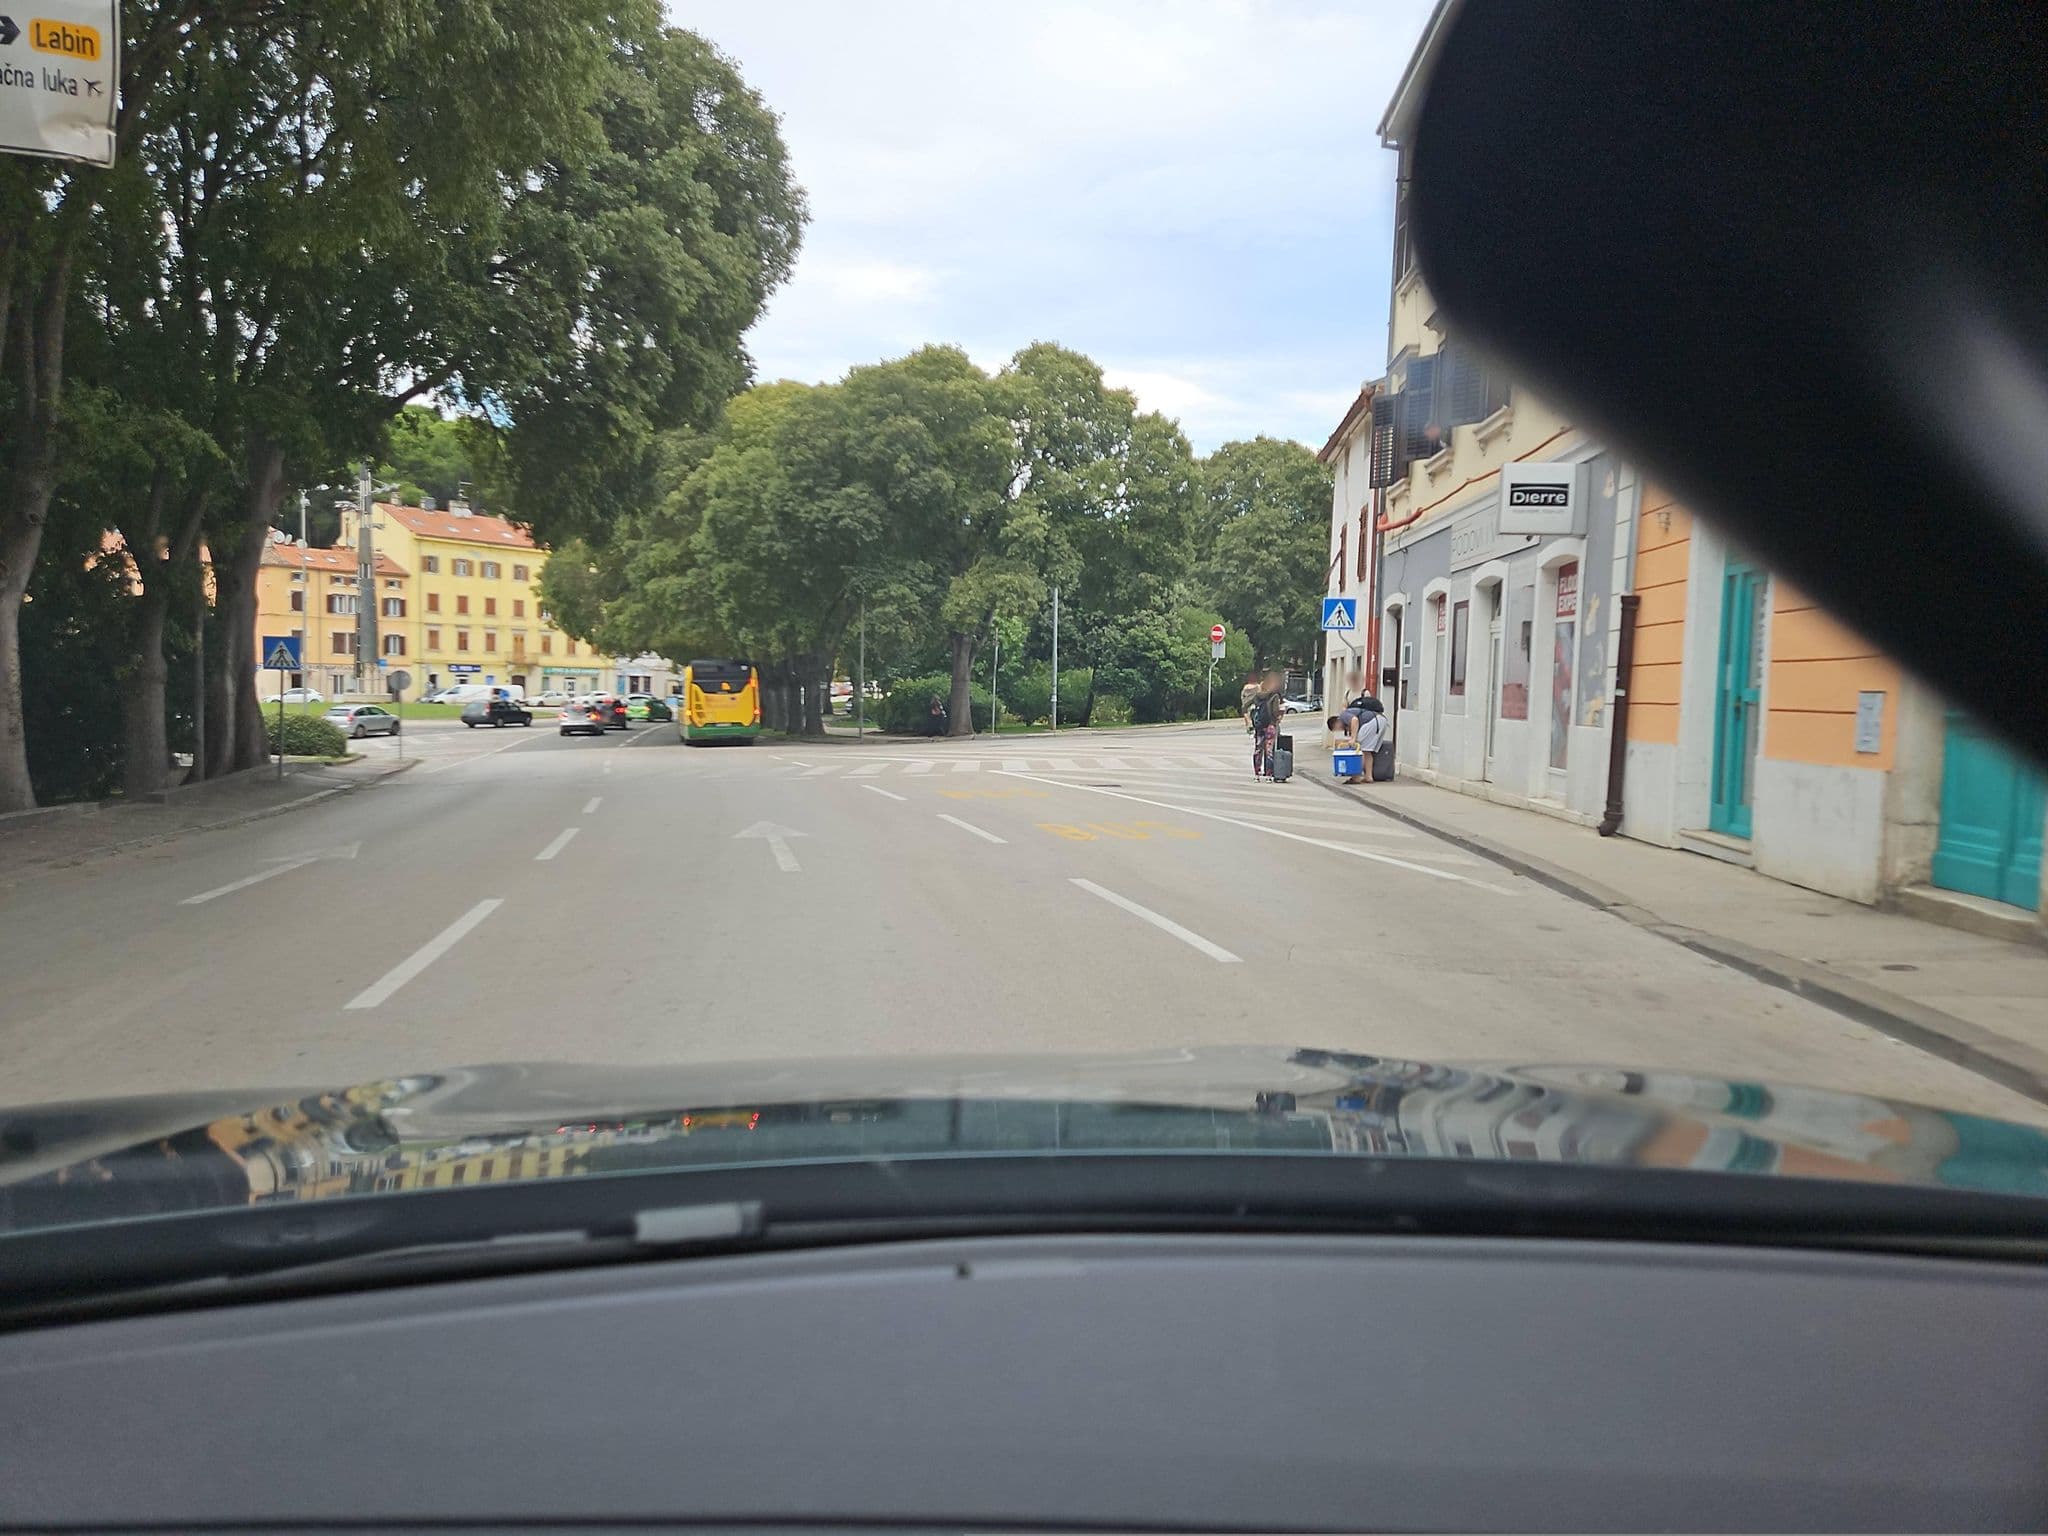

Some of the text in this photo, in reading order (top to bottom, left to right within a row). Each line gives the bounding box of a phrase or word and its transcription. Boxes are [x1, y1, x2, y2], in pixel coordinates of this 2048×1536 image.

[36, 22, 95, 56] Labin
[0, 62, 78, 96] čna luka
[1512, 491, 1566, 504] Dierre
